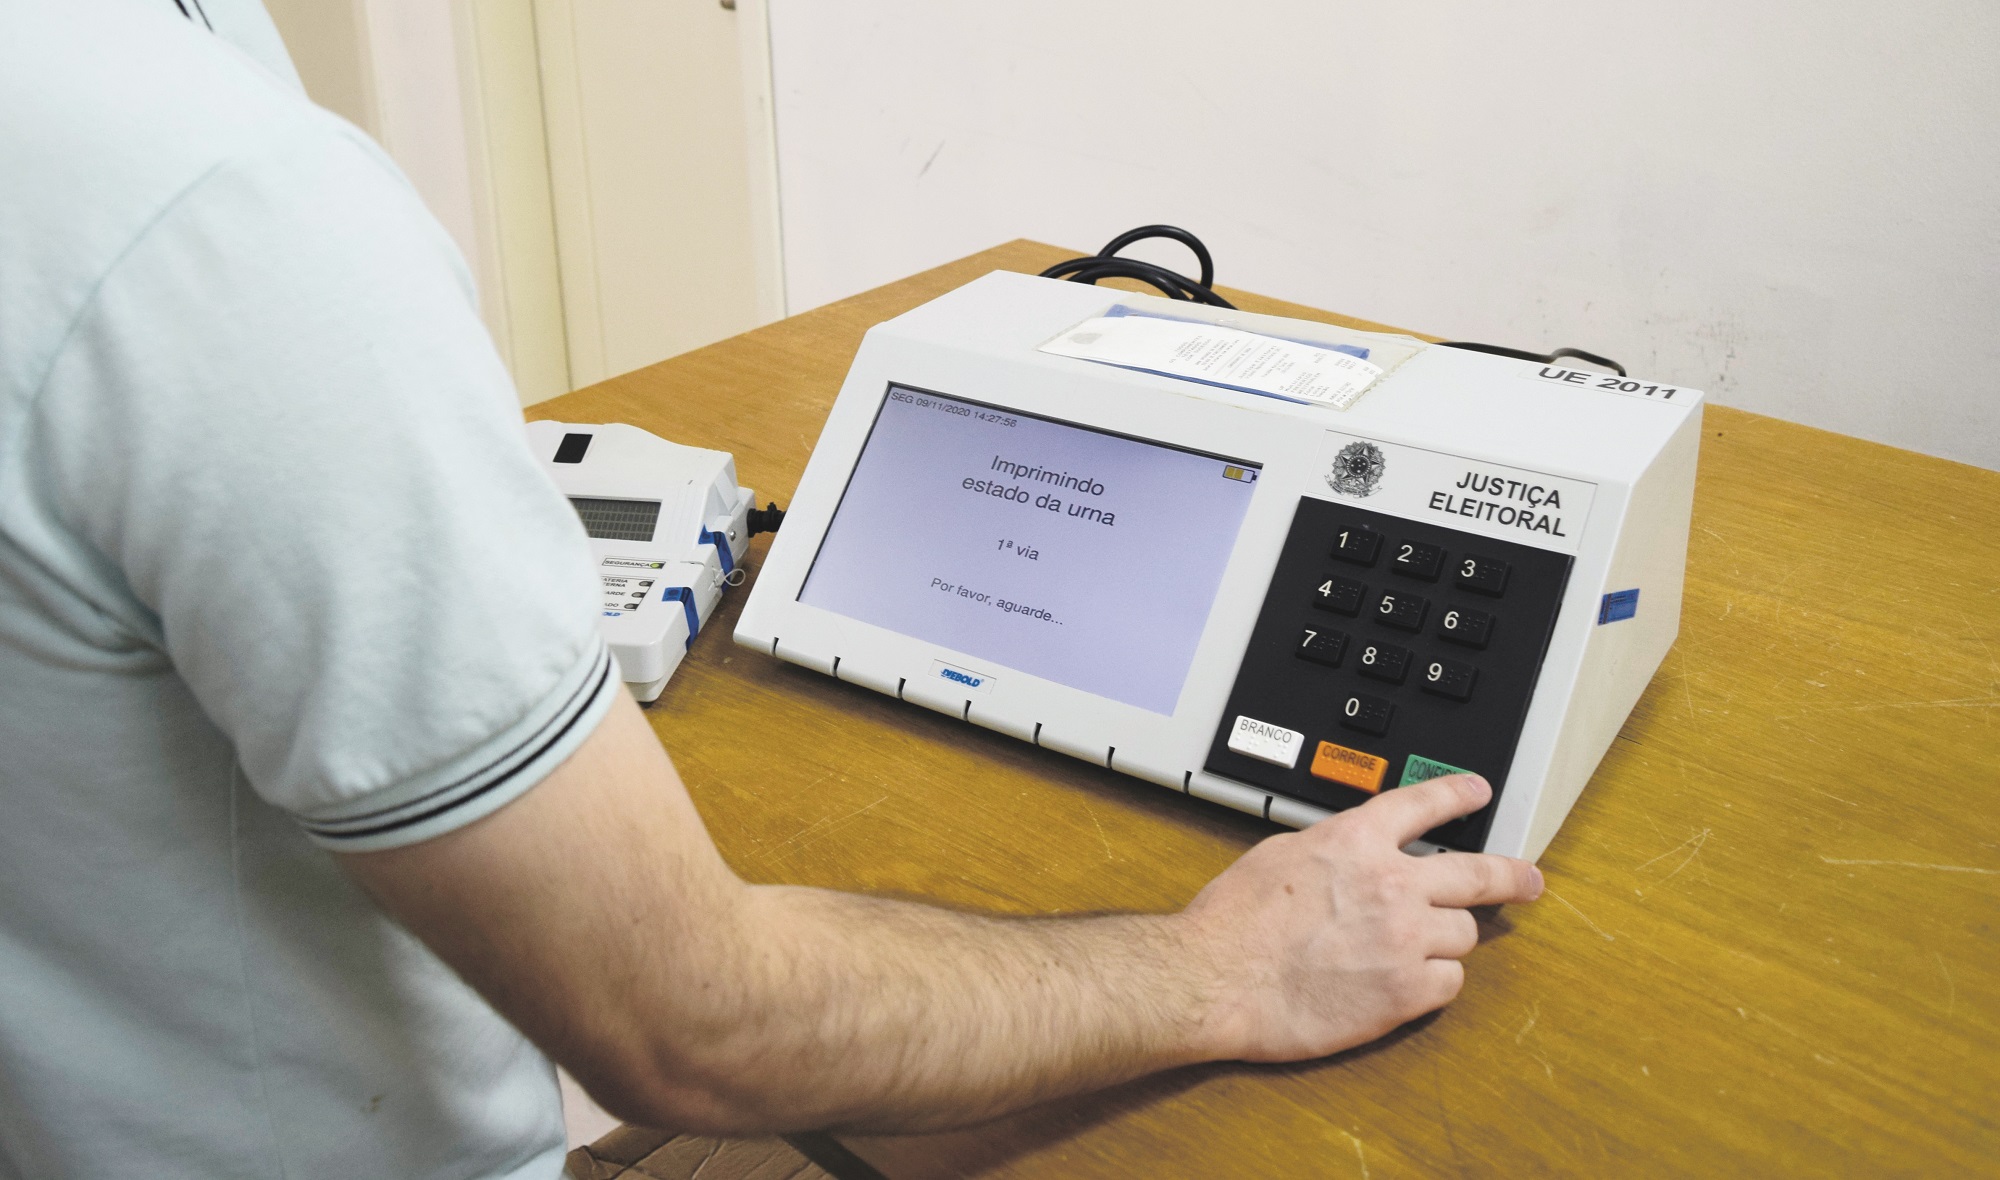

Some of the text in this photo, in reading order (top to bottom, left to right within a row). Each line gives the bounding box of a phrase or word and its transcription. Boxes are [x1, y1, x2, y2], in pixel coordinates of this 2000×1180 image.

[1537, 366, 1678, 400] UE 2011
[891, 392, 914, 404] SEG
[916, 398, 971, 416] 09/11/2020
[991, 455, 1105, 496] Imprimindo
[1456, 471, 1561, 510] JUSTIÇA
[962, 476, 1116, 526] estado da urna
[1428, 491, 1567, 538] ELEITORAL
[997, 538, 1040, 561] 1ª via
[1338, 531, 1350, 549] 1
[1397, 545, 1414, 564] 2
[1460, 559, 1476, 578] 3
[1318, 579, 1333, 598] 4
[930, 577, 1065, 626] Por favor, aguarde...
[1379, 595, 1395, 614] 5
[1443, 611, 1460, 630] 6
[1302, 630, 1317, 648] 7
[1362, 647, 1378, 665] 8
[941, 669, 980, 687] DIEBOLD
[1427, 663, 1443, 682] 9
[1345, 698, 1360, 717] 0
[1240, 718, 1293, 744] BRANCO
[1322, 745, 1377, 770] CORRIGE
